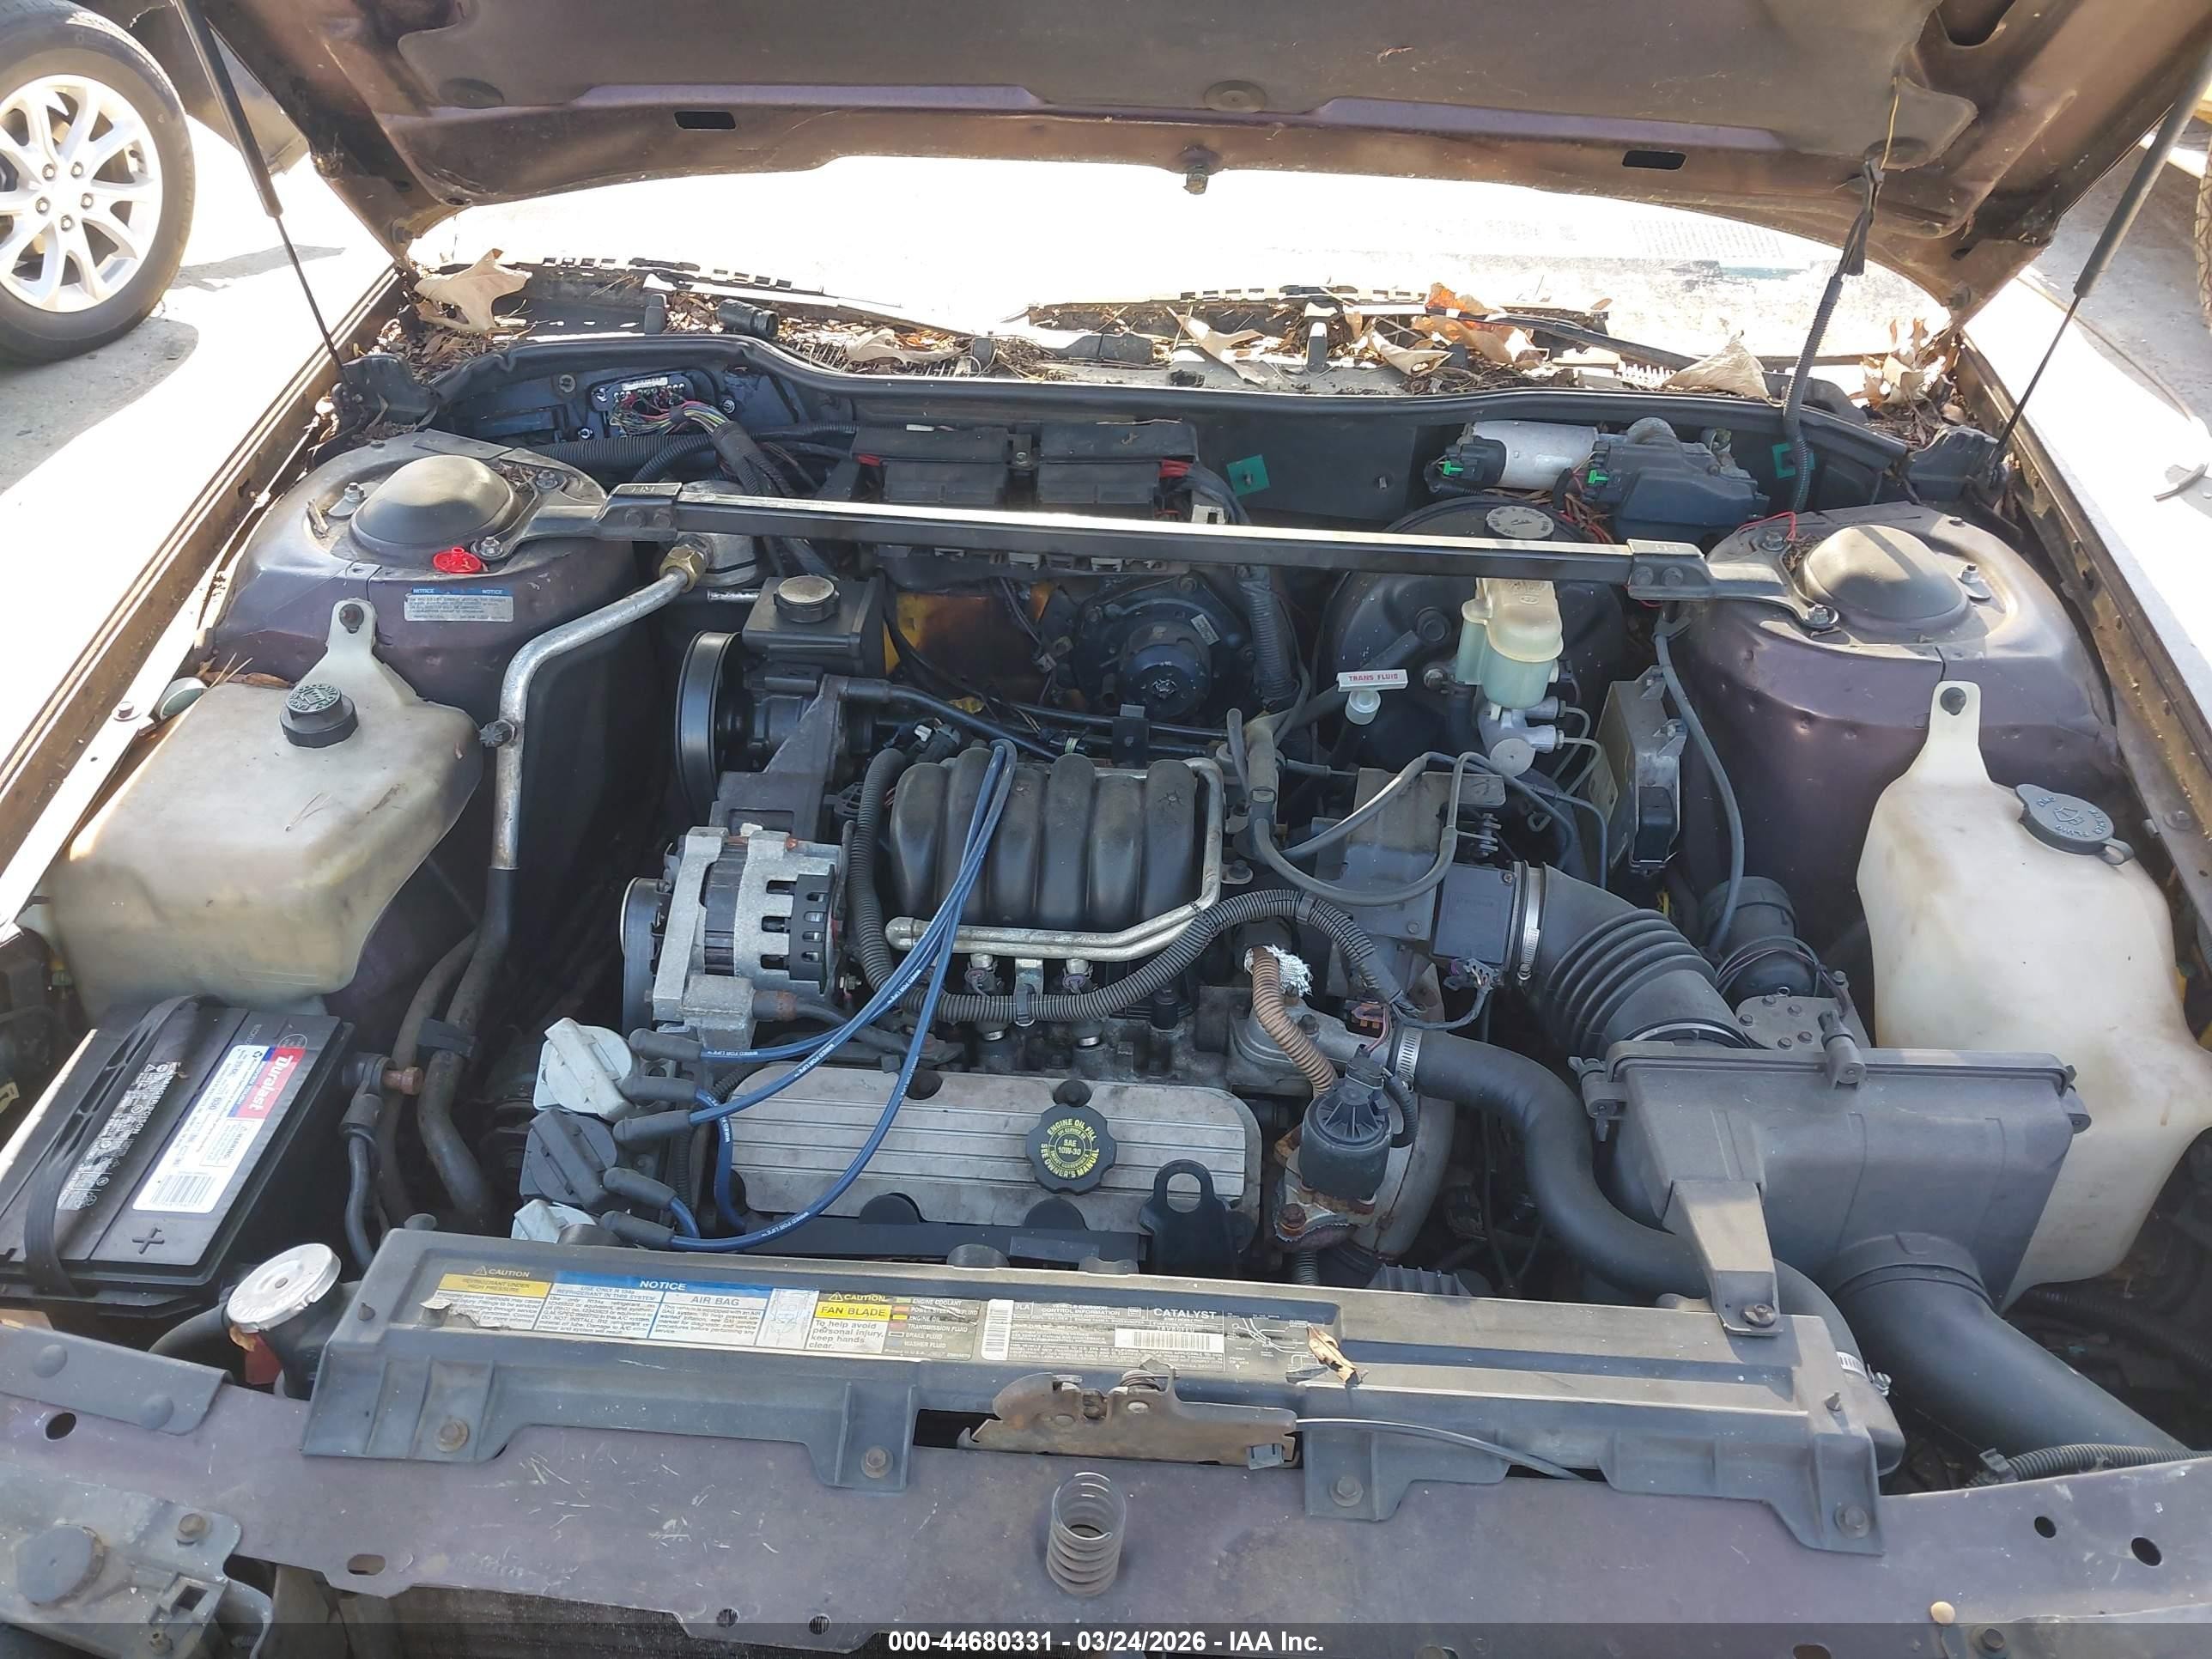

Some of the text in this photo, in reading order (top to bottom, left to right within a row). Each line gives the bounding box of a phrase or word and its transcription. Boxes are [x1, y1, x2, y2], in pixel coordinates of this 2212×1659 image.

[246, 1055, 295, 1110] Duralast
[1047, 1118, 1097, 1141] ENGINE OIL FILL
[1058, 1147, 1081, 1155] 10W-30
[1044, 1158, 1076, 1178] OWNER'S
[1076, 1148, 1100, 1176] MANUAL
[488, 1268, 530, 1278] CAUTION
[639, 1280, 687, 1291] NOTICE
[689, 1295, 740, 1306] AIR BAG
[821, 1307, 886, 1316] FAN BLADE
[1154, 1308, 1217, 1319] CATALYST
[828, 1320, 848, 1329] help
[908, 1324, 951, 1332] TRANSMISSION
[812, 1327, 853, 1335] personal
[811, 1334, 833, 1343] keep
[808, 1341, 834, 1349] clear.
